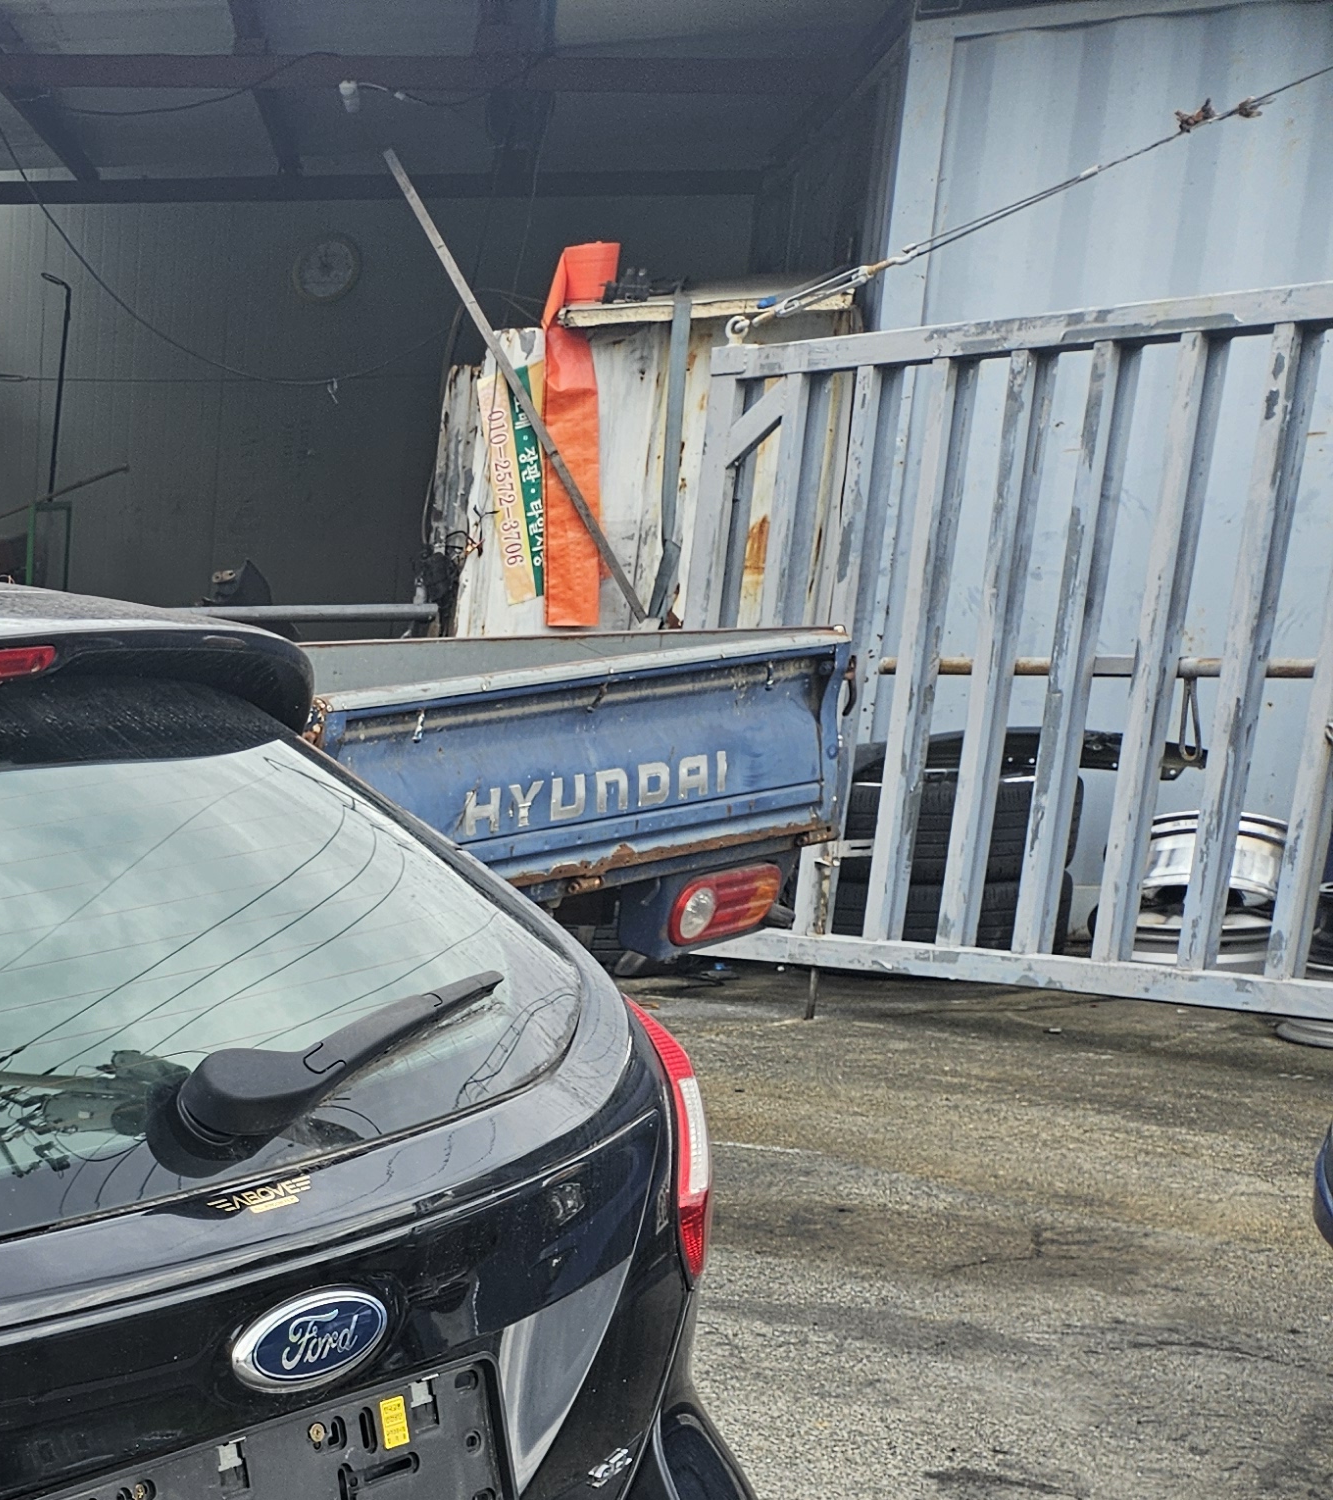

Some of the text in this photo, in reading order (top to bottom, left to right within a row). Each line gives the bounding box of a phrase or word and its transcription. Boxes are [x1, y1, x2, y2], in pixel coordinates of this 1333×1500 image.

[487, 410, 524, 566] 010-2572-3706
[519, 446, 542, 483] 장판
[464, 750, 728, 836] HYUNDAI
[232, 1180, 302, 1210] ABOVE
[281, 1308, 359, 1371] Ford
